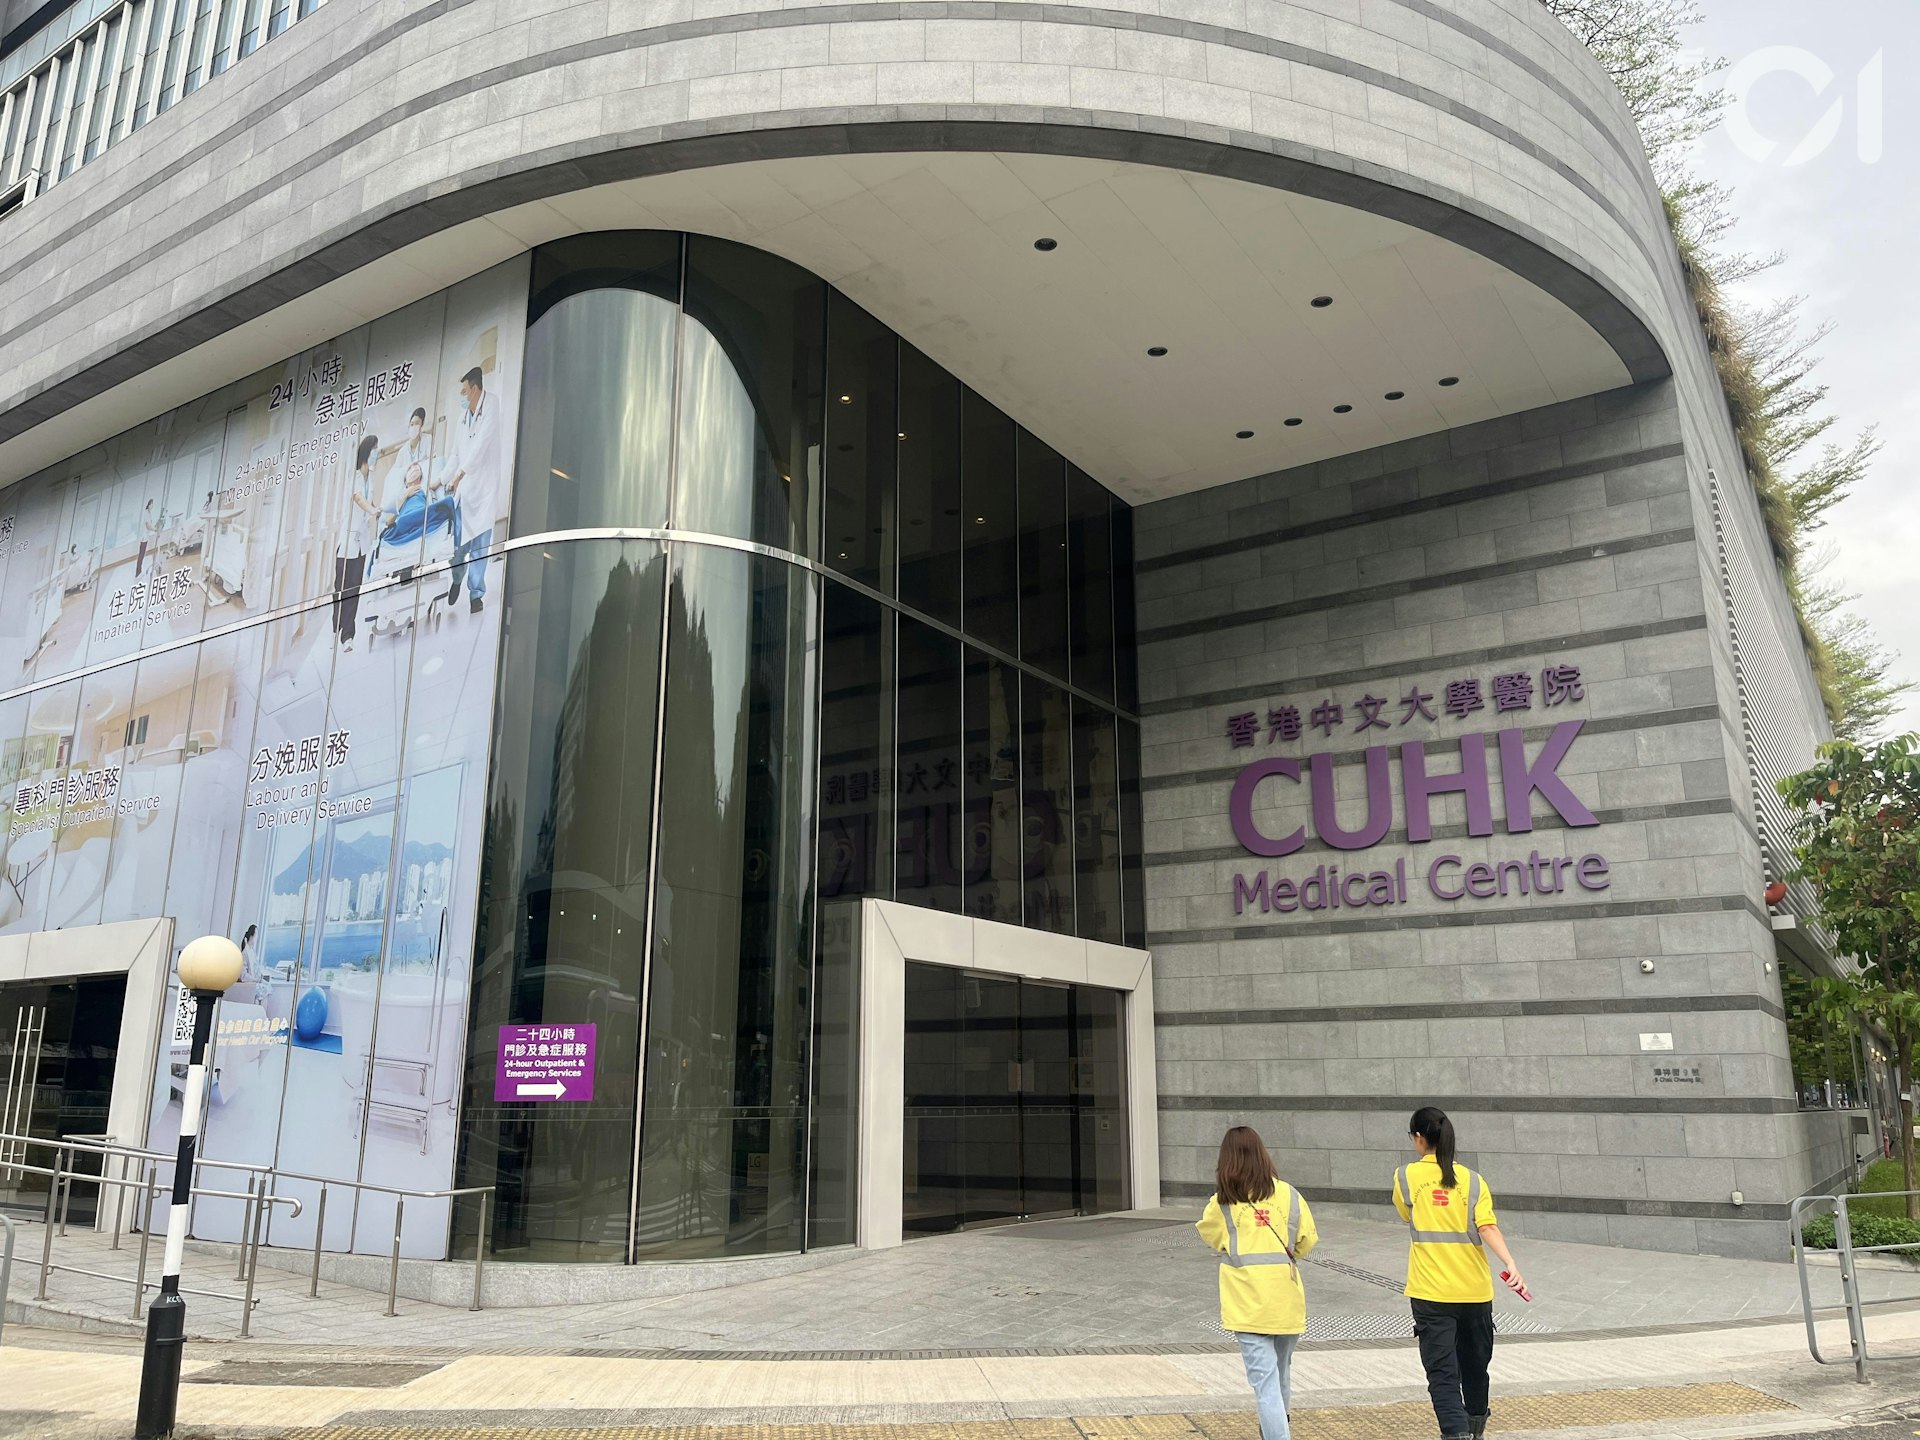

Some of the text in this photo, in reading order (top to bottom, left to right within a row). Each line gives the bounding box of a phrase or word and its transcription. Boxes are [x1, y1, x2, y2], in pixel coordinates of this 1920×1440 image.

[314, 361, 413, 426] 急症服務
[235, 419, 368, 481] 24-hour Emergency
[225, 451, 338, 503] Medicine Service
[109, 567, 191, 620] 住院服務
[94, 603, 191, 642] Inpatient Service
[1227, 664, 1585, 748] 香港中文大學醫院
[250, 730, 350, 783] 分娩服務
[15, 766, 121, 815] 專科門診服務
[247, 776, 329, 807] Labour and
[257, 796, 372, 829] Delivery Service
[1229, 719, 1600, 857] CUHK
[10, 794, 160, 837] Specialist Outpatient Service
[1233, 850, 1610, 914] Medical Centre
[504, 1043, 587, 1057] 門診及急症服務
[516, 1028, 575, 1041] 二十四小時
[504, 1059, 585, 1068] 24-hour Outpatient &
[506, 1069, 582, 1078] Emergency Services
